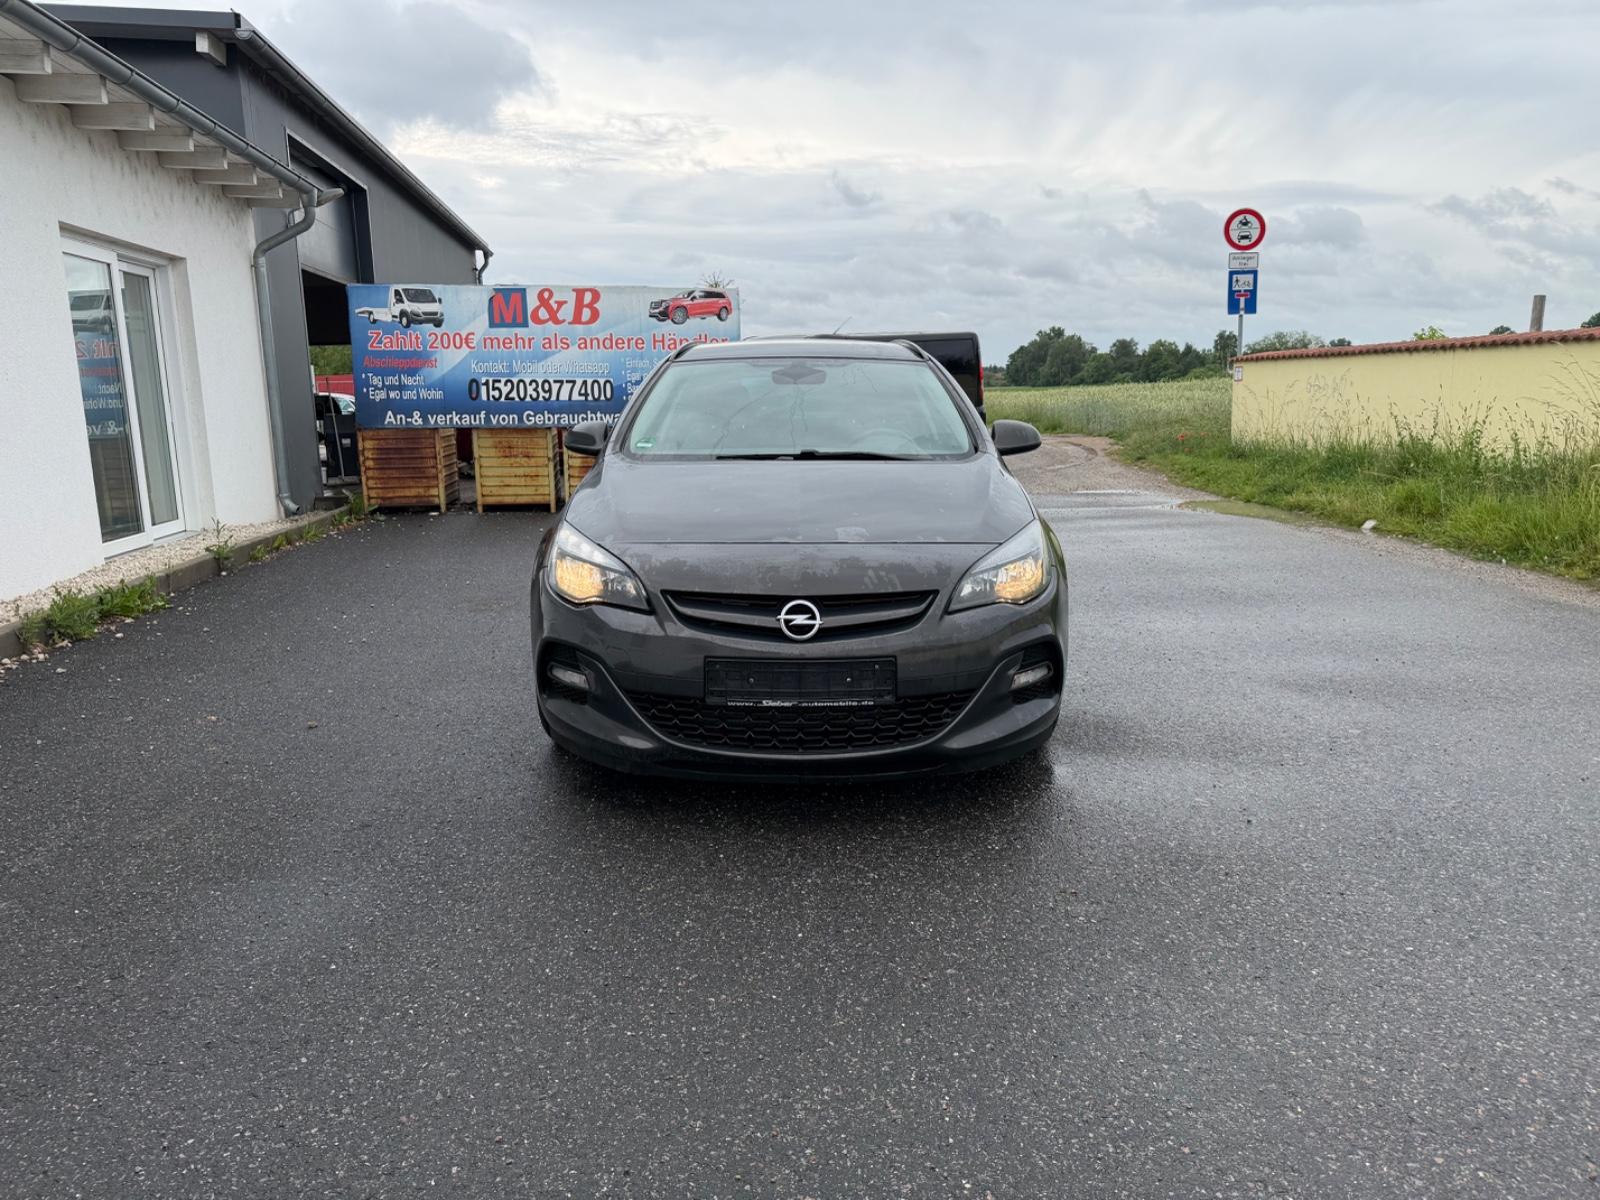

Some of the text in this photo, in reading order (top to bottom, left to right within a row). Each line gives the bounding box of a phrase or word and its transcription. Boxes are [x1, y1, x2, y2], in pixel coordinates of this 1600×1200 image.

[368, 330, 422, 350] Zahlt
[427, 332, 475, 350] 200€
[483, 333, 535, 350] mehr
[542, 333, 570, 350] als
[577, 333, 645, 350] andere
[363, 356, 438, 369] Abschleppdienst
[471, 360, 509, 373] Kontakt:
[512, 360, 538, 373] Mobil
[539, 360, 561, 373] oder
[368, 373, 425, 387] Tag und Nacht
[369, 387, 444, 401] Egal wo und Wohin
[468, 378, 614, 401] 015203977400
[384, 410, 423, 425] An-&
[428, 410, 486, 425] verkauf
[490, 413, 518, 425] von
